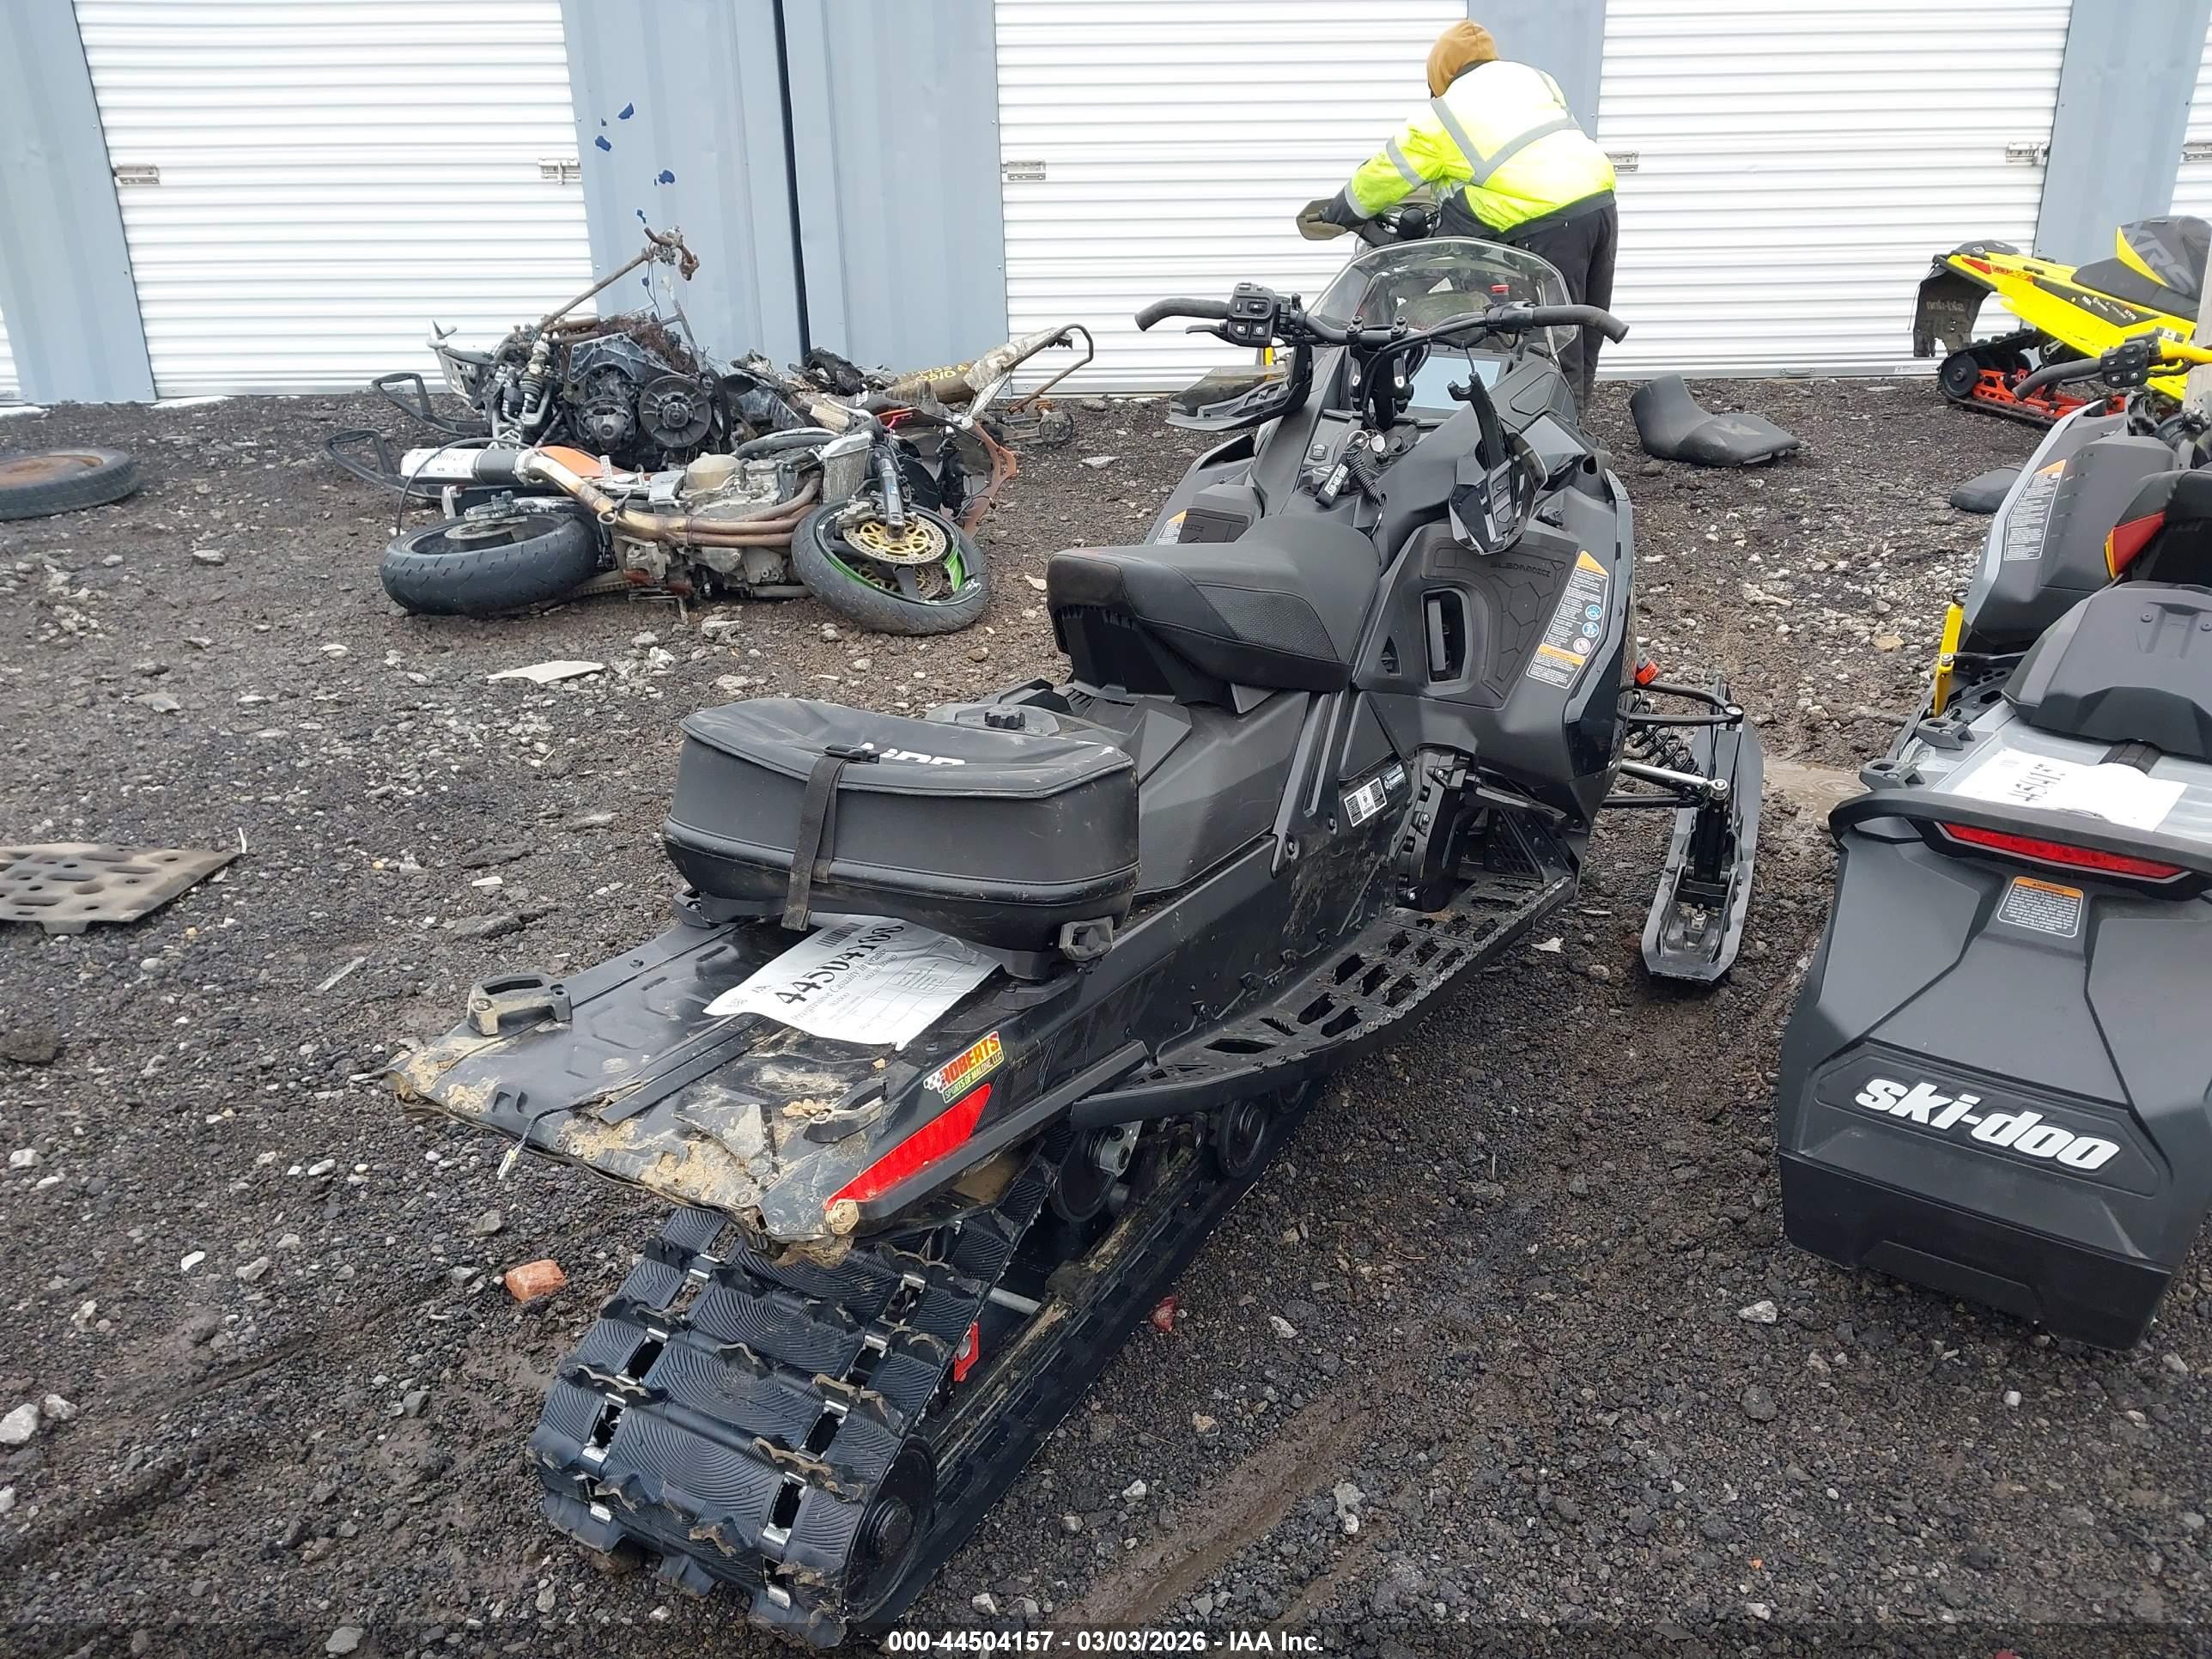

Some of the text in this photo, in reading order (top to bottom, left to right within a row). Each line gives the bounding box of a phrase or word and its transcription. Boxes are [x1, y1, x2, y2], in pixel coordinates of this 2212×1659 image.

[830, 969, 861, 993] Casualty
[942, 1034, 1000, 1086] ROBERTS
[945, 1079, 966, 1099] SPORTS
[963, 1073, 973, 1087] OF
[992, 1050, 1003, 1066] LLC
[1855, 1079, 2121, 1170] ski-doo
